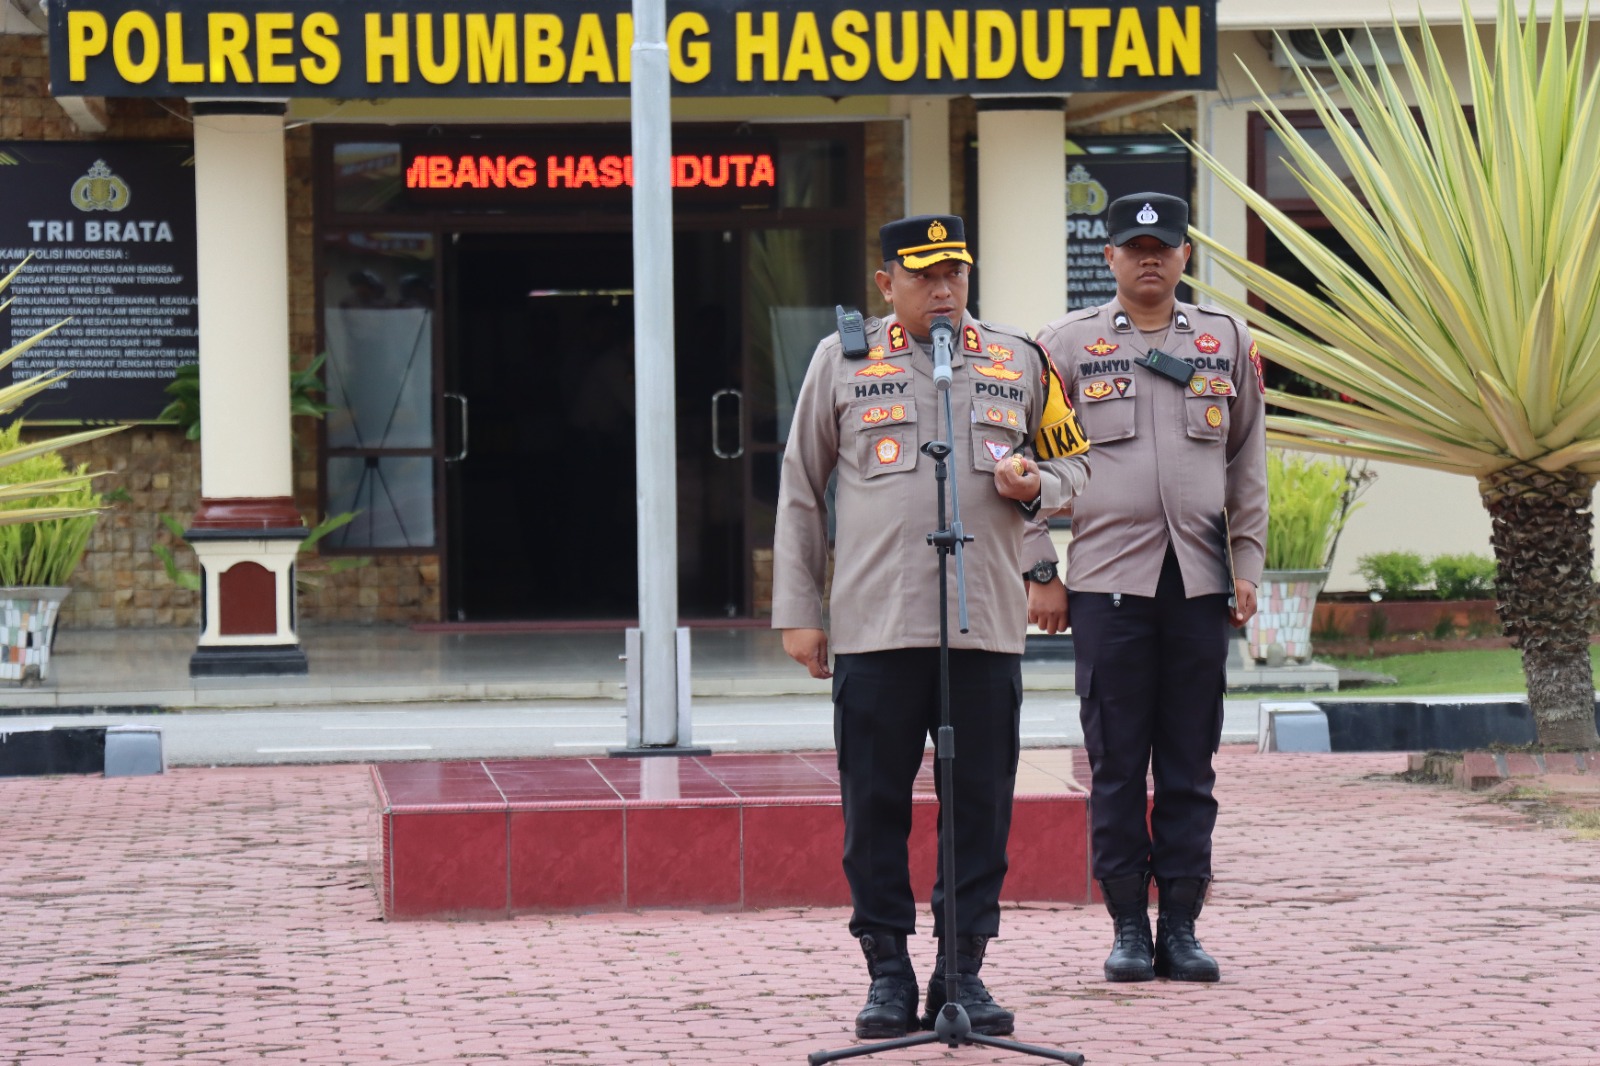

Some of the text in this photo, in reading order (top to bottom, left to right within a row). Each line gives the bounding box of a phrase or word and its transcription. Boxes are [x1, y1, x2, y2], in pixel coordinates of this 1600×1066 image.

[68, 10, 342, 84] POLRES
[735, 6, 1201, 82] HASUNDUTAN
[547, 154, 775, 188] HASDUTA
[28, 221, 174, 242] TRI BRATA
[1066, 219, 1109, 239] PRA
[0, 249, 26, 260] KAMI
[28, 249, 63, 260] POLISI
[65, 249, 123, 260] INDONESIA
[55, 265, 89, 273] KEPADA
[91, 265, 115, 273] NUSA
[117, 265, 135, 273] DAN
[137, 265, 173, 273] BANGSA
[11, 275, 182, 284] DENGAN PENUH KETAKWAAN TERHADAP
[11, 286, 40, 294] TUHAN
[42, 286, 66, 294] YANG
[68, 286, 93, 294] MAHA
[11, 296, 70, 305] MENJUNJUNG
[72, 296, 100, 305] TINGGI
[160, 296, 198, 305] KEADILA
[11, 307, 189, 315] DAN KEMANUSIAAN DALAM MENEGAKKAN
[11, 317, 43, 326] HUKUM
[83, 317, 128, 326] KESATUAN
[130, 317, 173, 326] REPUBLIK
[11, 328, 198, 336] INDONA YANG BERDASARKAN PANCASILA
[110, 339, 140, 347] DASAR
[143, 339, 162, 347] 1945
[14, 350, 66, 358] NANTIASA
[124, 350, 176, 358] MENGAYOMI
[178, 350, 196, 358] DAN
[12, 360, 198, 368] MELAYANI MASYARAKAT DENGAN KEIKLAS
[1080, 358, 1130, 376] WAHYU
[107, 371, 156, 379] KEAMANAN
[158, 371, 177, 379] DAN
[855, 382, 908, 398] HARY
[975, 382, 1024, 402] POLRI
